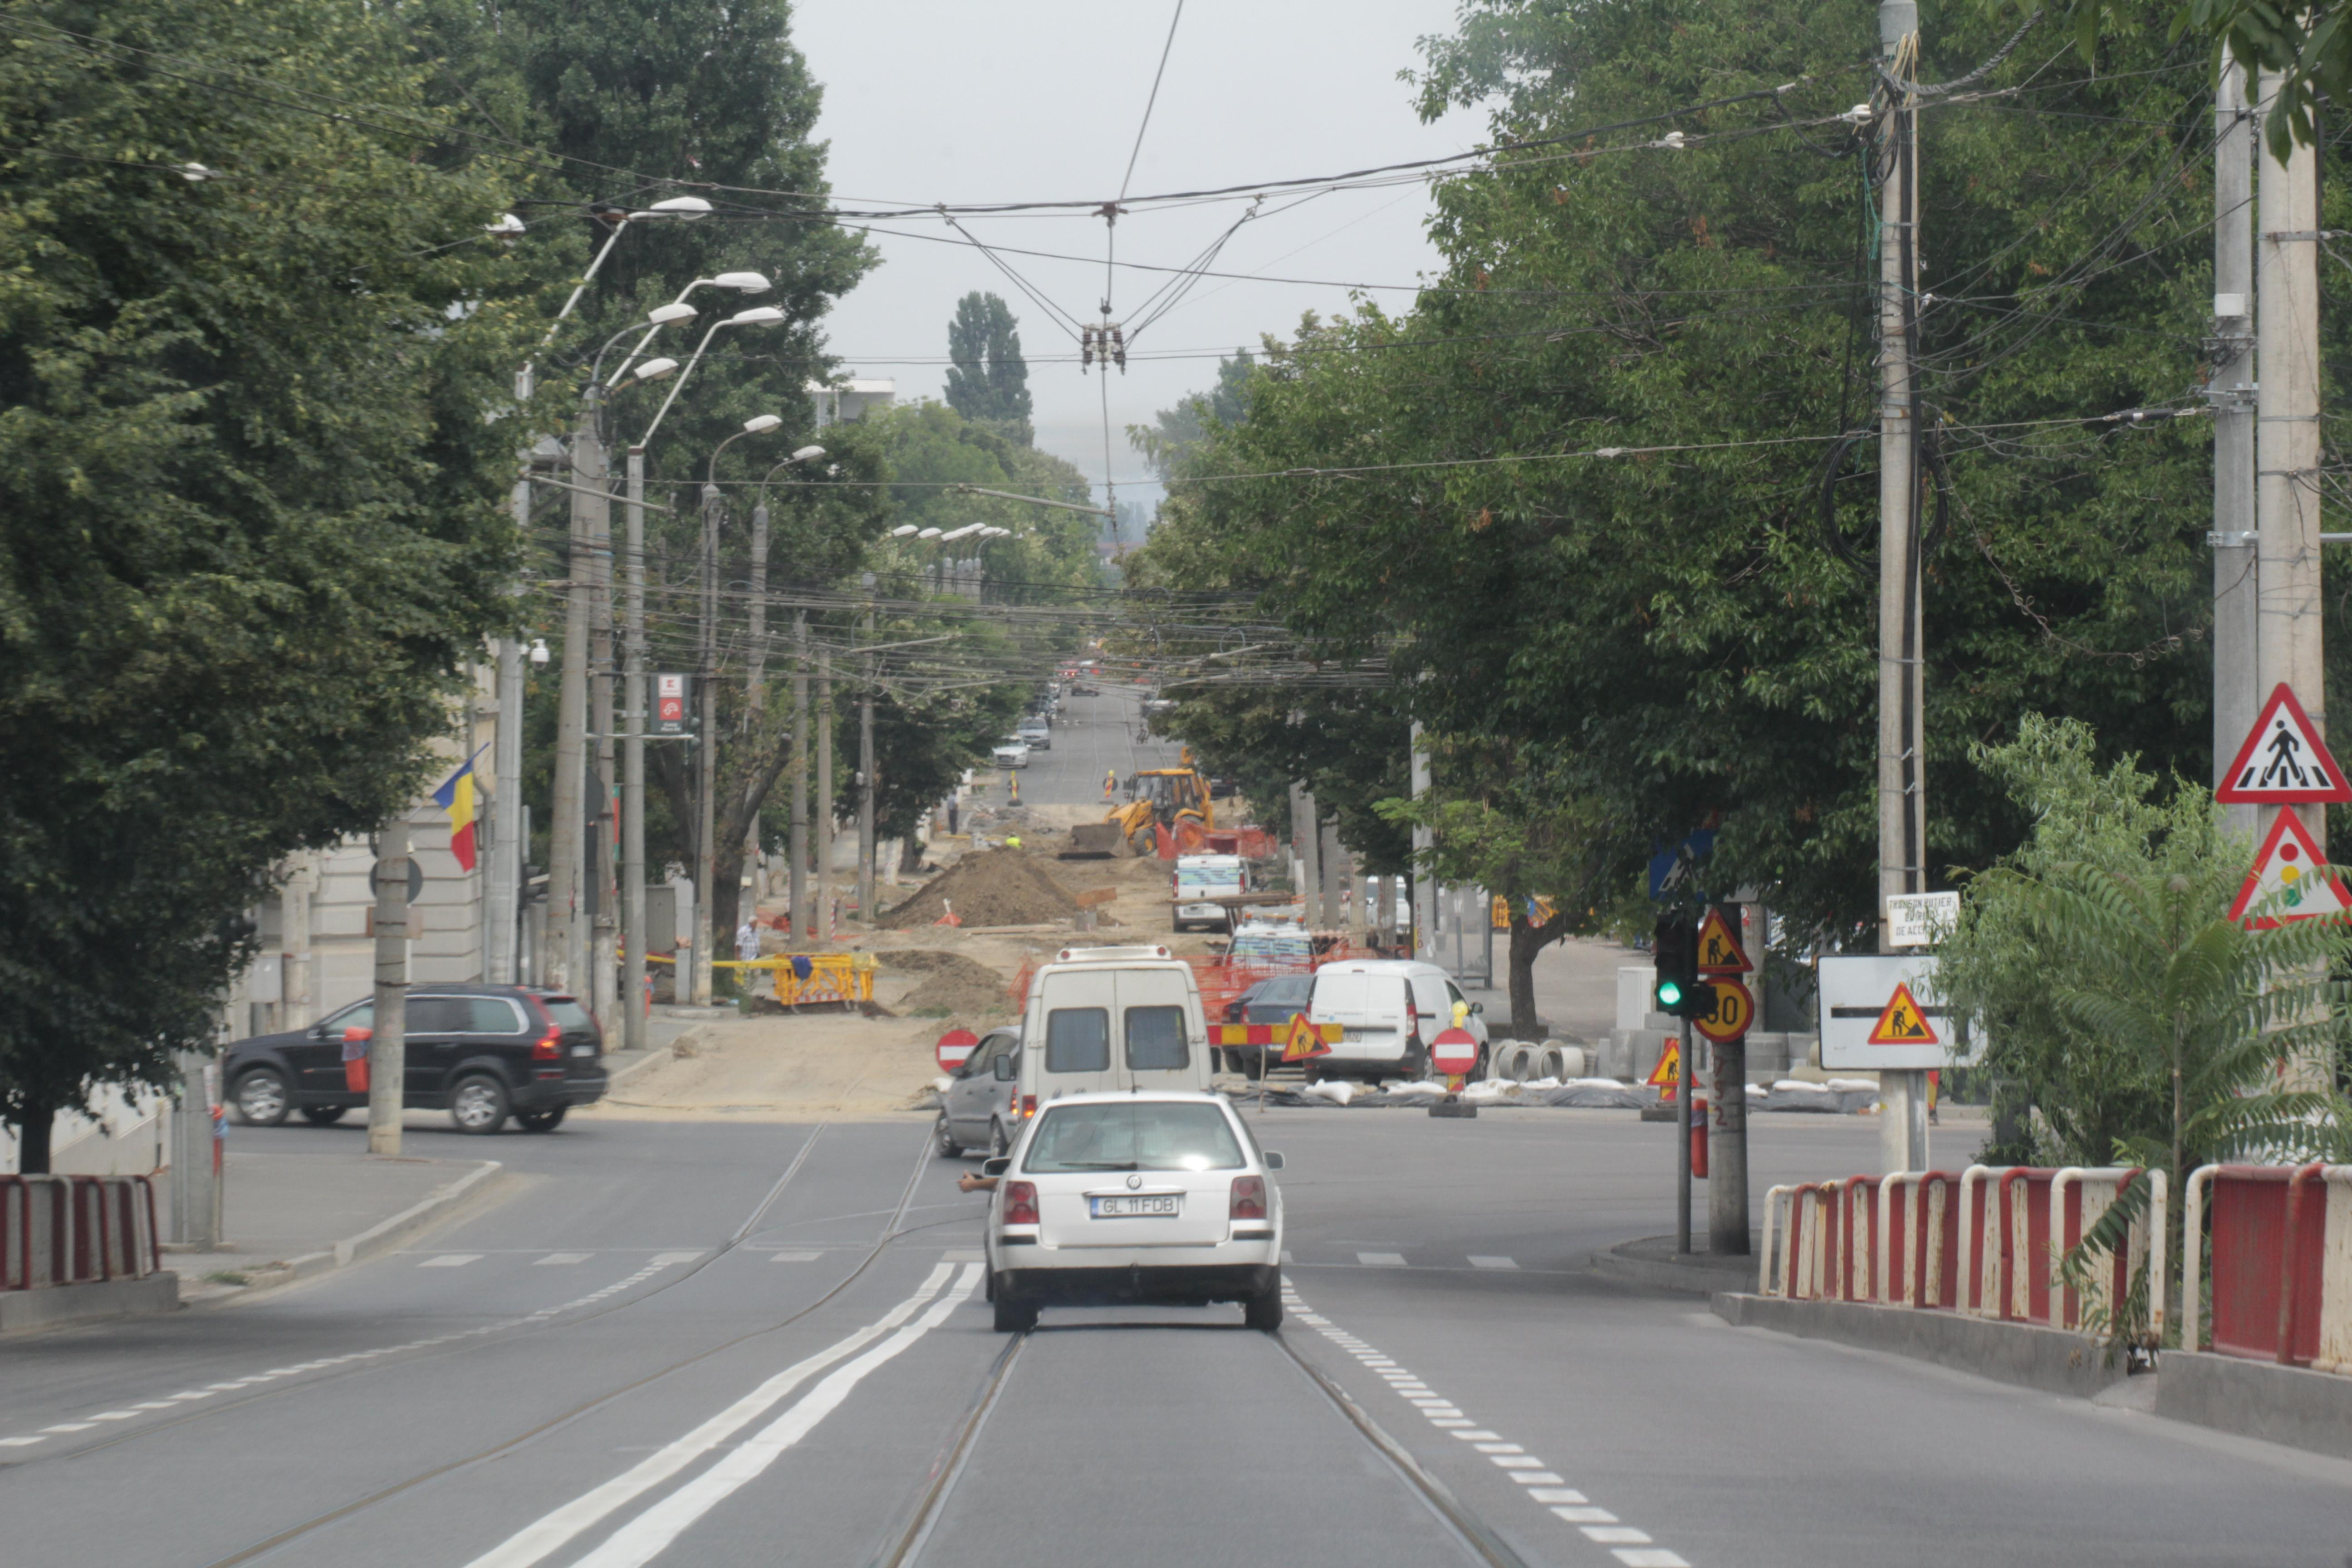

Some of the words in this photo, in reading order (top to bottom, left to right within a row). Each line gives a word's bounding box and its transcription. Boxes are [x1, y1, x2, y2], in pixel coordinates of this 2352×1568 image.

[1896, 926, 1906, 936] DE
[1103, 1199, 1122, 1213] GL
[1142, 1198, 1173, 1212] FDB
